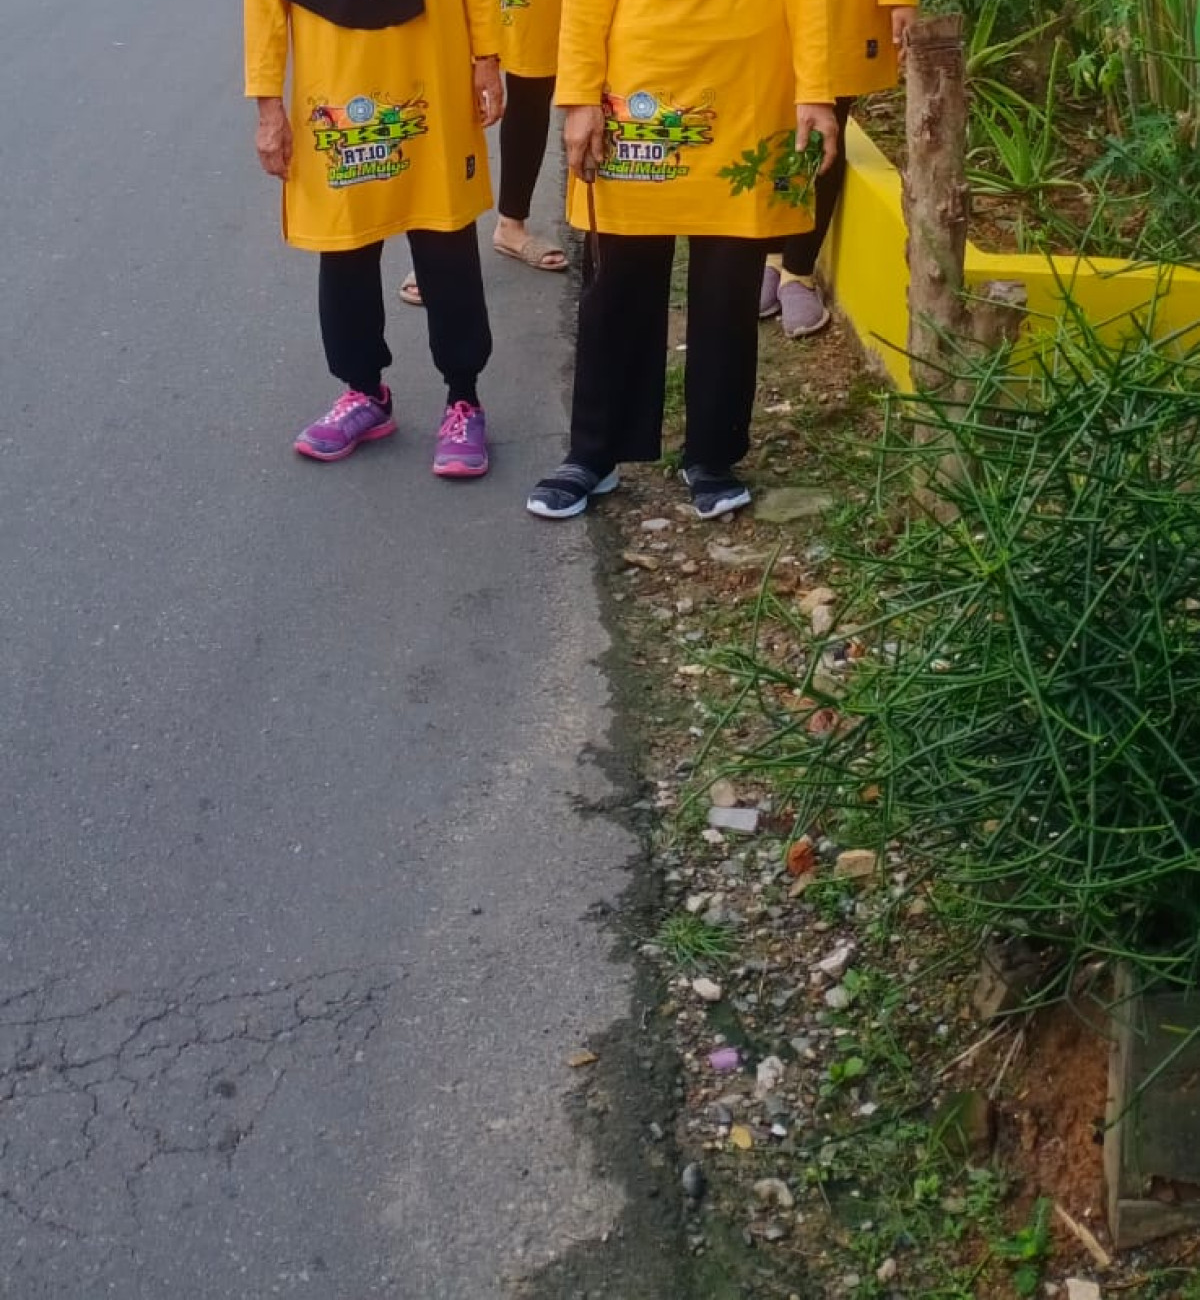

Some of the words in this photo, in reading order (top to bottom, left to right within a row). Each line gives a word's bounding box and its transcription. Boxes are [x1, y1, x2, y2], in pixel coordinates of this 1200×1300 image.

[313, 115, 428, 150] PKK
[344, 144, 387, 165] RT.10
[618, 142, 663, 160] RT.10
